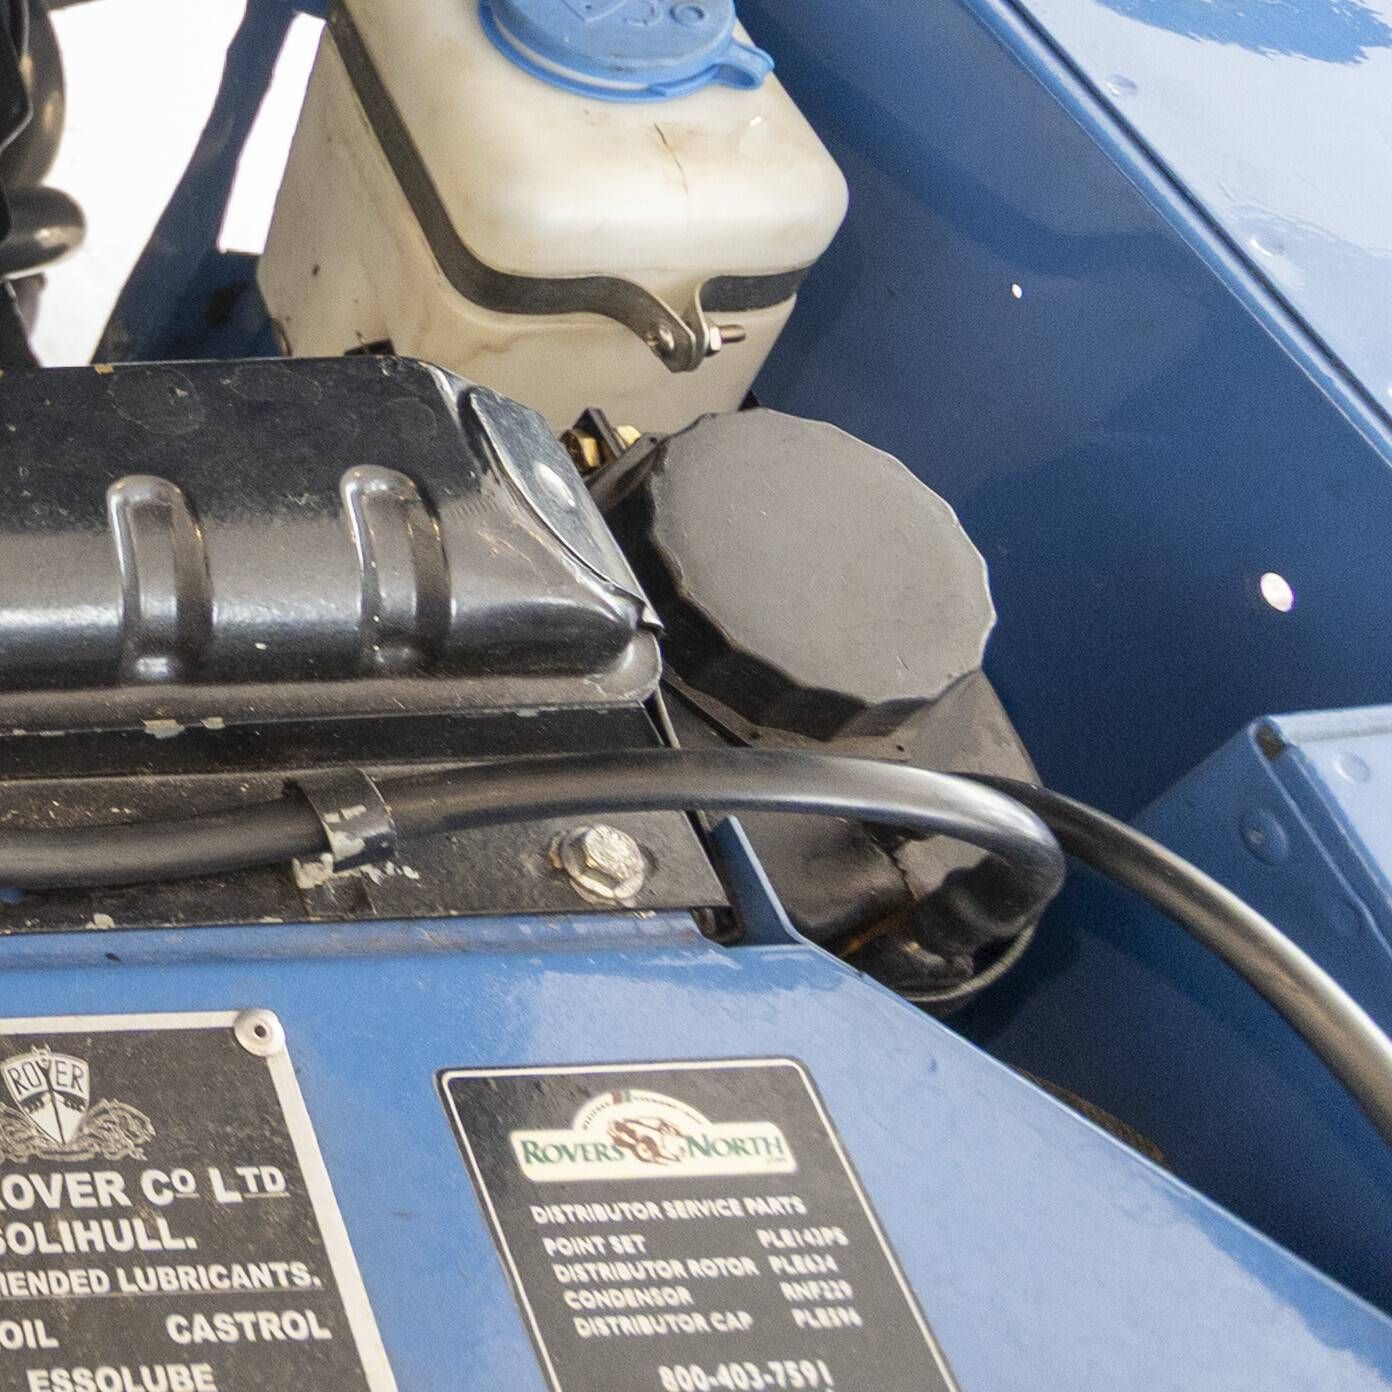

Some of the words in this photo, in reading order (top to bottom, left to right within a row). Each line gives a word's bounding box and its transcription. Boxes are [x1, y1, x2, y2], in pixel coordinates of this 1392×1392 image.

[6, 1057, 88, 1097] ROVER
[529, 1202, 662, 1225] DISTRIBUTOR
[663, 1199, 744, 1221] SERVICE
[745, 1195, 808, 1217] PARTS
[543, 1235, 607, 1258] POINT
[611, 1233, 648, 1255] SET
[117, 1262, 322, 1295] LUBRICANTS.
[552, 1260, 689, 1284] DISTRIBUTOR
[688, 1257, 760, 1279] ROTOR
[563, 1287, 694, 1310] CONDENSOR
[166, 1310, 333, 1345] CASTROL
[573, 1315, 711, 1339] DISTRIBUTOR
[713, 1311, 754, 1334] CAP
[26, 1362, 217, 1392] ESSOLUBE
[658, 1358, 835, 1392] 800-403-7591
